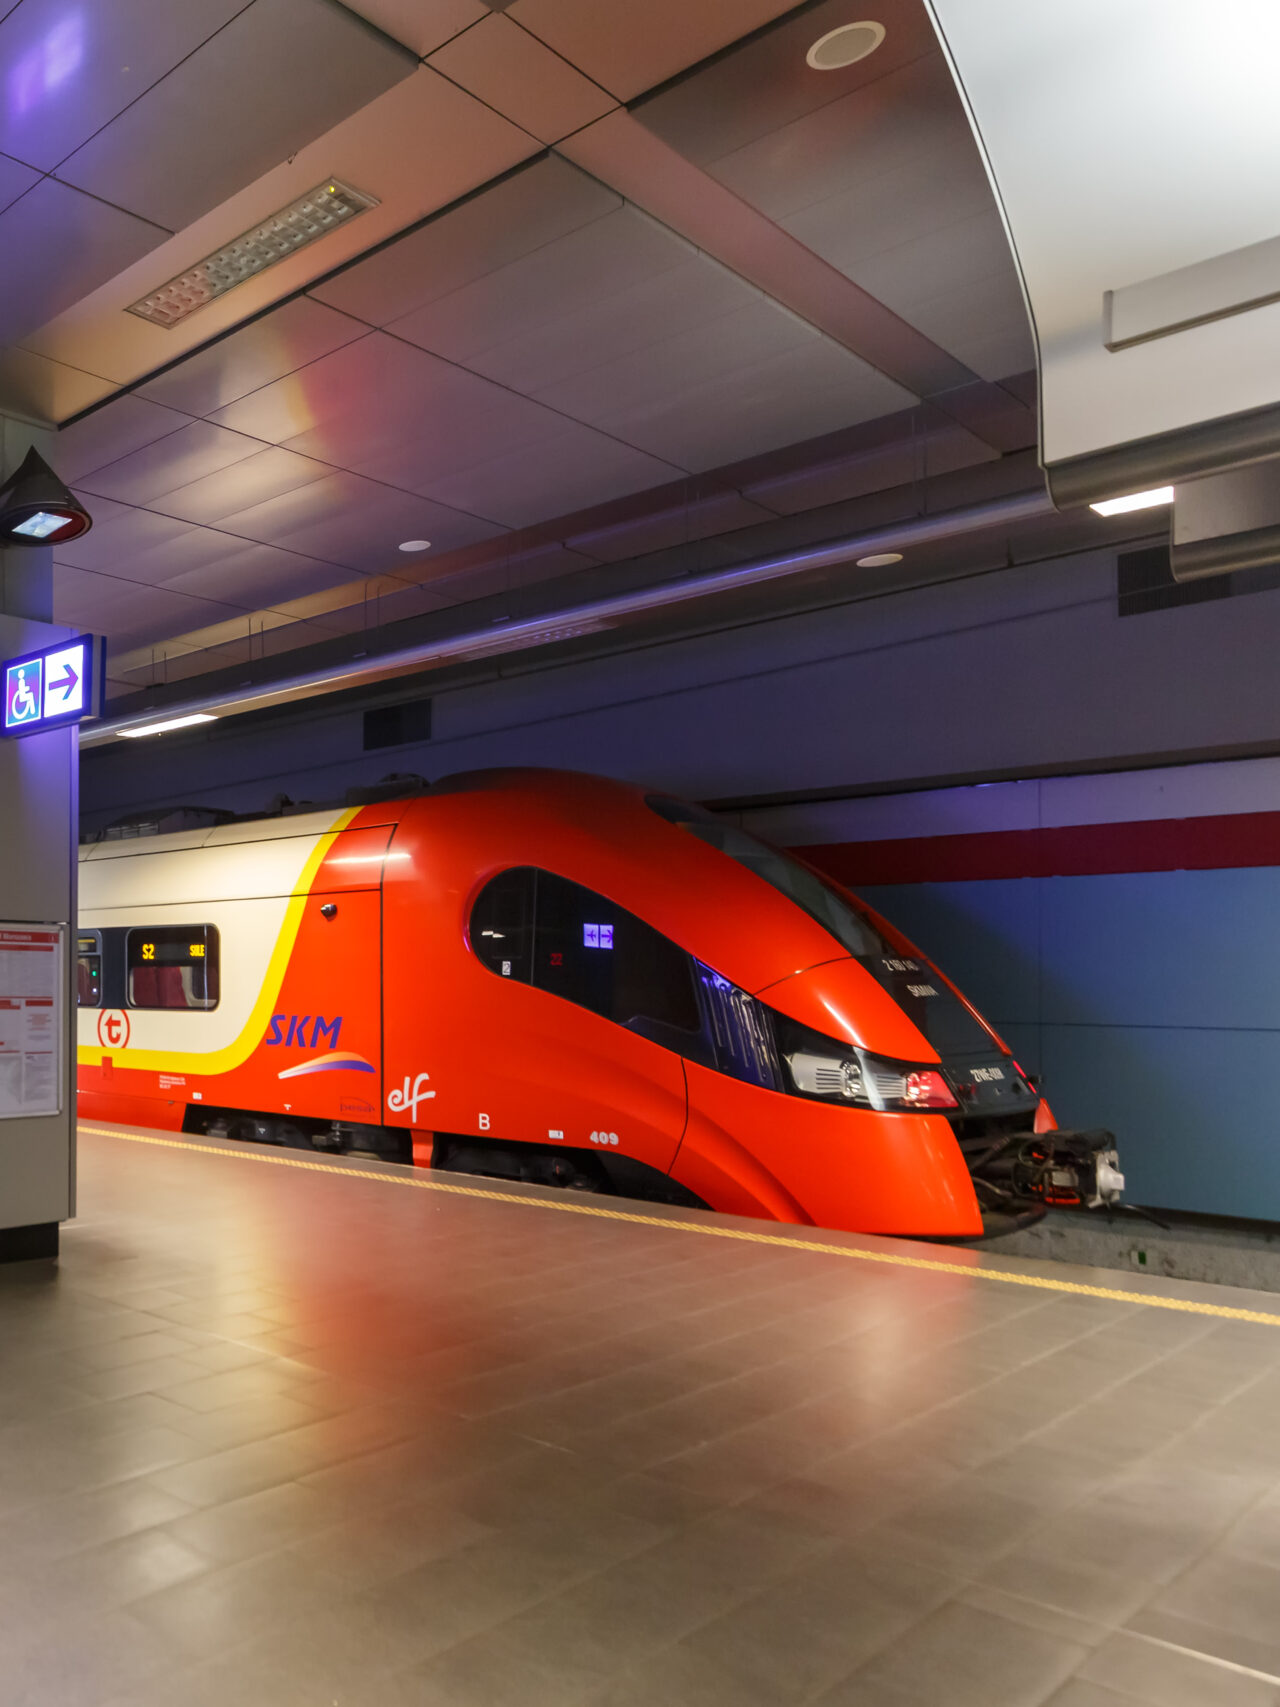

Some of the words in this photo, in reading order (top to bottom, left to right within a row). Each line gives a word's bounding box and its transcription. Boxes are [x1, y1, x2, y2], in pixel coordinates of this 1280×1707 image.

[142, 943, 155, 960] S2
[266, 1015, 344, 1049] SKM
[387, 1073, 436, 1123] elf
[478, 1113, 490, 1130] B
[589, 1131, 619, 1145] 409
